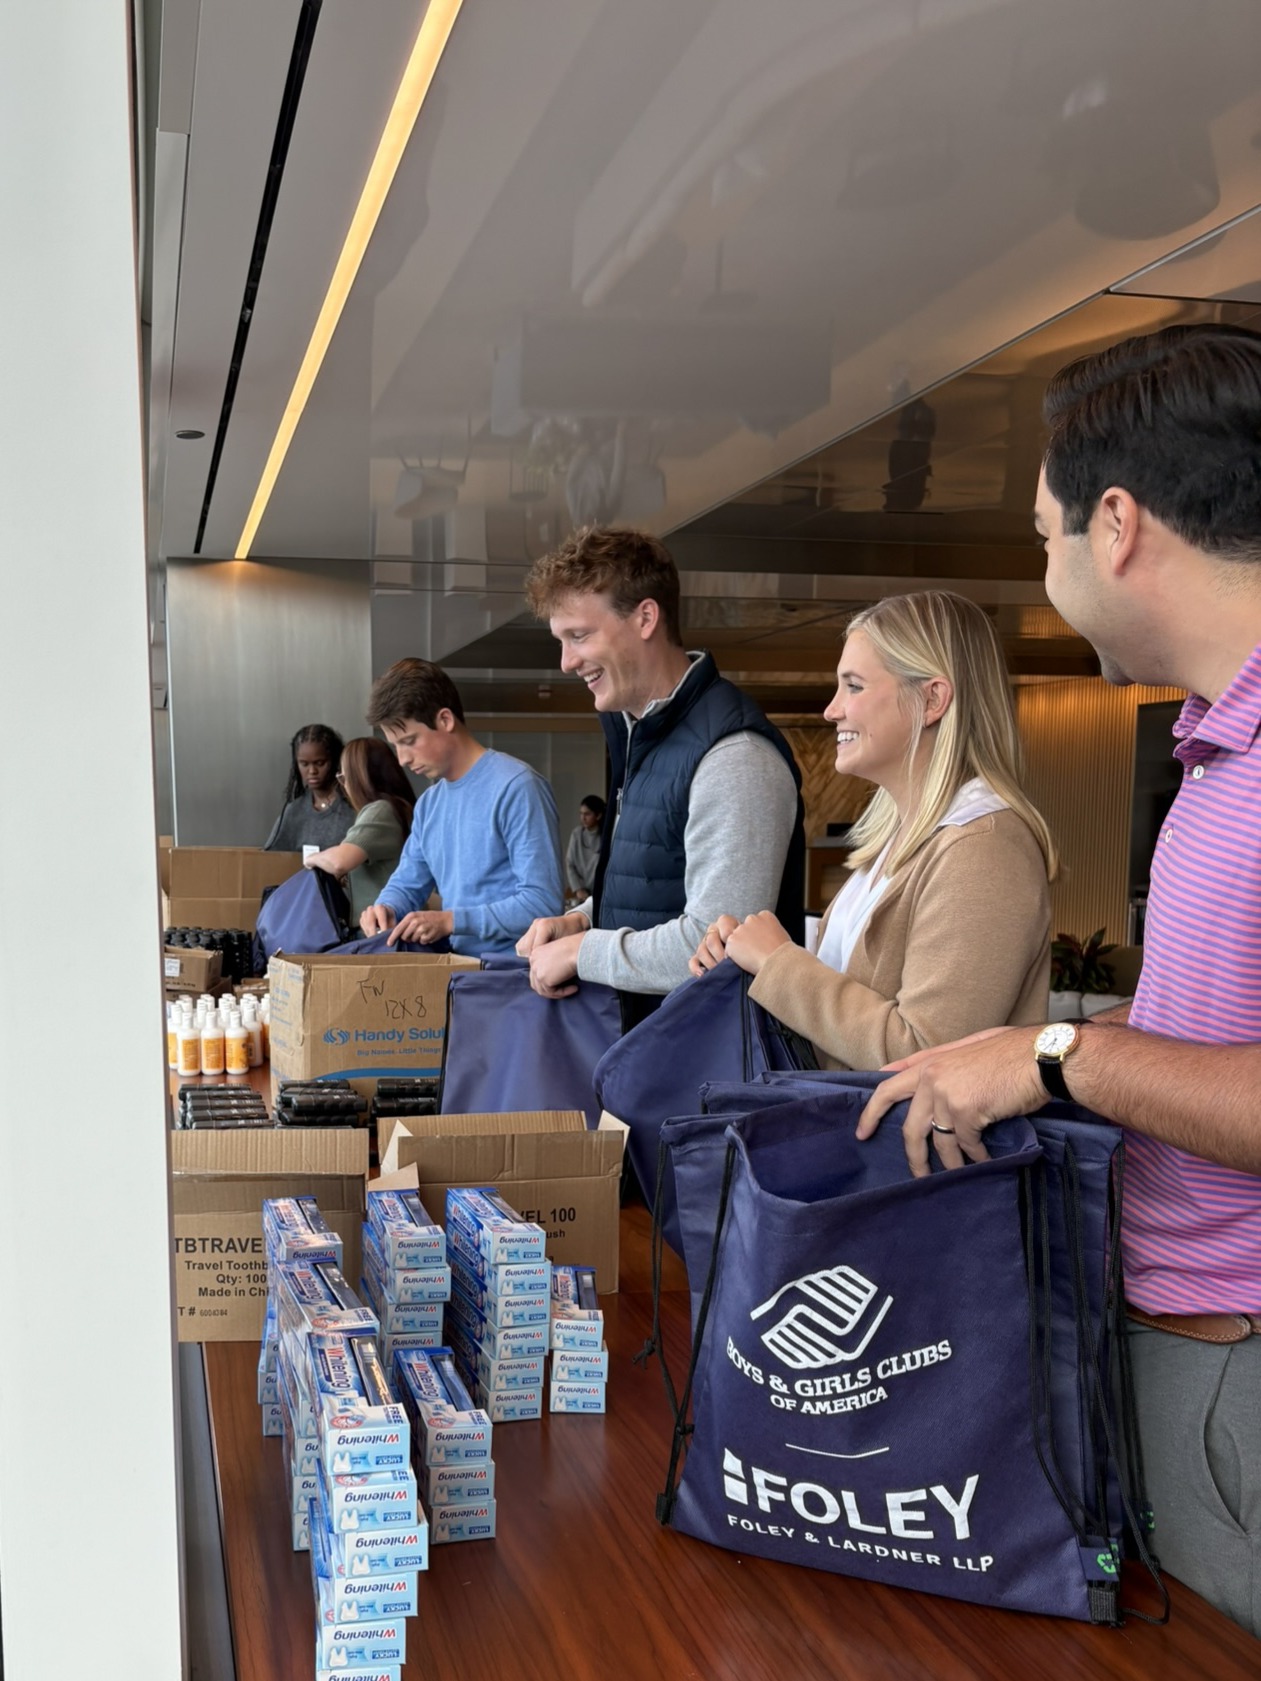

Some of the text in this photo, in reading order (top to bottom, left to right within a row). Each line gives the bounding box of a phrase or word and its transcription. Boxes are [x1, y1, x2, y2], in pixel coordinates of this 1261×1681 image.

[355, 1028, 404, 1043] Handy
[550, 1207, 576, 1223] 100
[397, 1241, 440, 1249] Whitening
[499, 1236, 539, 1245] Whitening
[293, 1250, 337, 1259] Whitening
[184, 1260, 223, 1271] Travel
[505, 1268, 545, 1277] Whitening
[216, 1273, 267, 1286] Qty: 100
[403, 1276, 445, 1284] Whitening
[198, 1287, 231, 1297] Made
[234, 1287, 246, 1297] in
[504, 1299, 544, 1308] Whitening
[188, 1306, 196, 1317] #
[394, 1304, 437, 1315] Whitening
[555, 1322, 597, 1332] Whitening
[503, 1332, 543, 1341] Whitening
[392, 1337, 434, 1348] Whitening
[560, 1354, 601, 1363] Whitening
[326, 1348, 352, 1389] Whitening
[498, 1362, 538, 1371] Whitening
[727, 1336, 953, 1397] BOYS & GIRLS CLUBS
[414, 1362, 439, 1397] Whitening
[557, 1385, 599, 1394] Whitening
[495, 1393, 536, 1402] Whitening
[770, 1386, 888, 1415] OF AMERICA
[337, 1433, 400, 1446] Whitening
[435, 1432, 485, 1442] Whitening
[438, 1471, 487, 1481] Whitening
[344, 1490, 408, 1503] Whitening
[751, 1466, 979, 1541] FOLEY
[439, 1508, 488, 1519] Whitening
[355, 1535, 418, 1548] Whitening
[727, 1514, 995, 1573] FOLEY & LARDNER LLP
[344, 1582, 407, 1595] Whitening
[333, 1628, 396, 1641] Whitening
